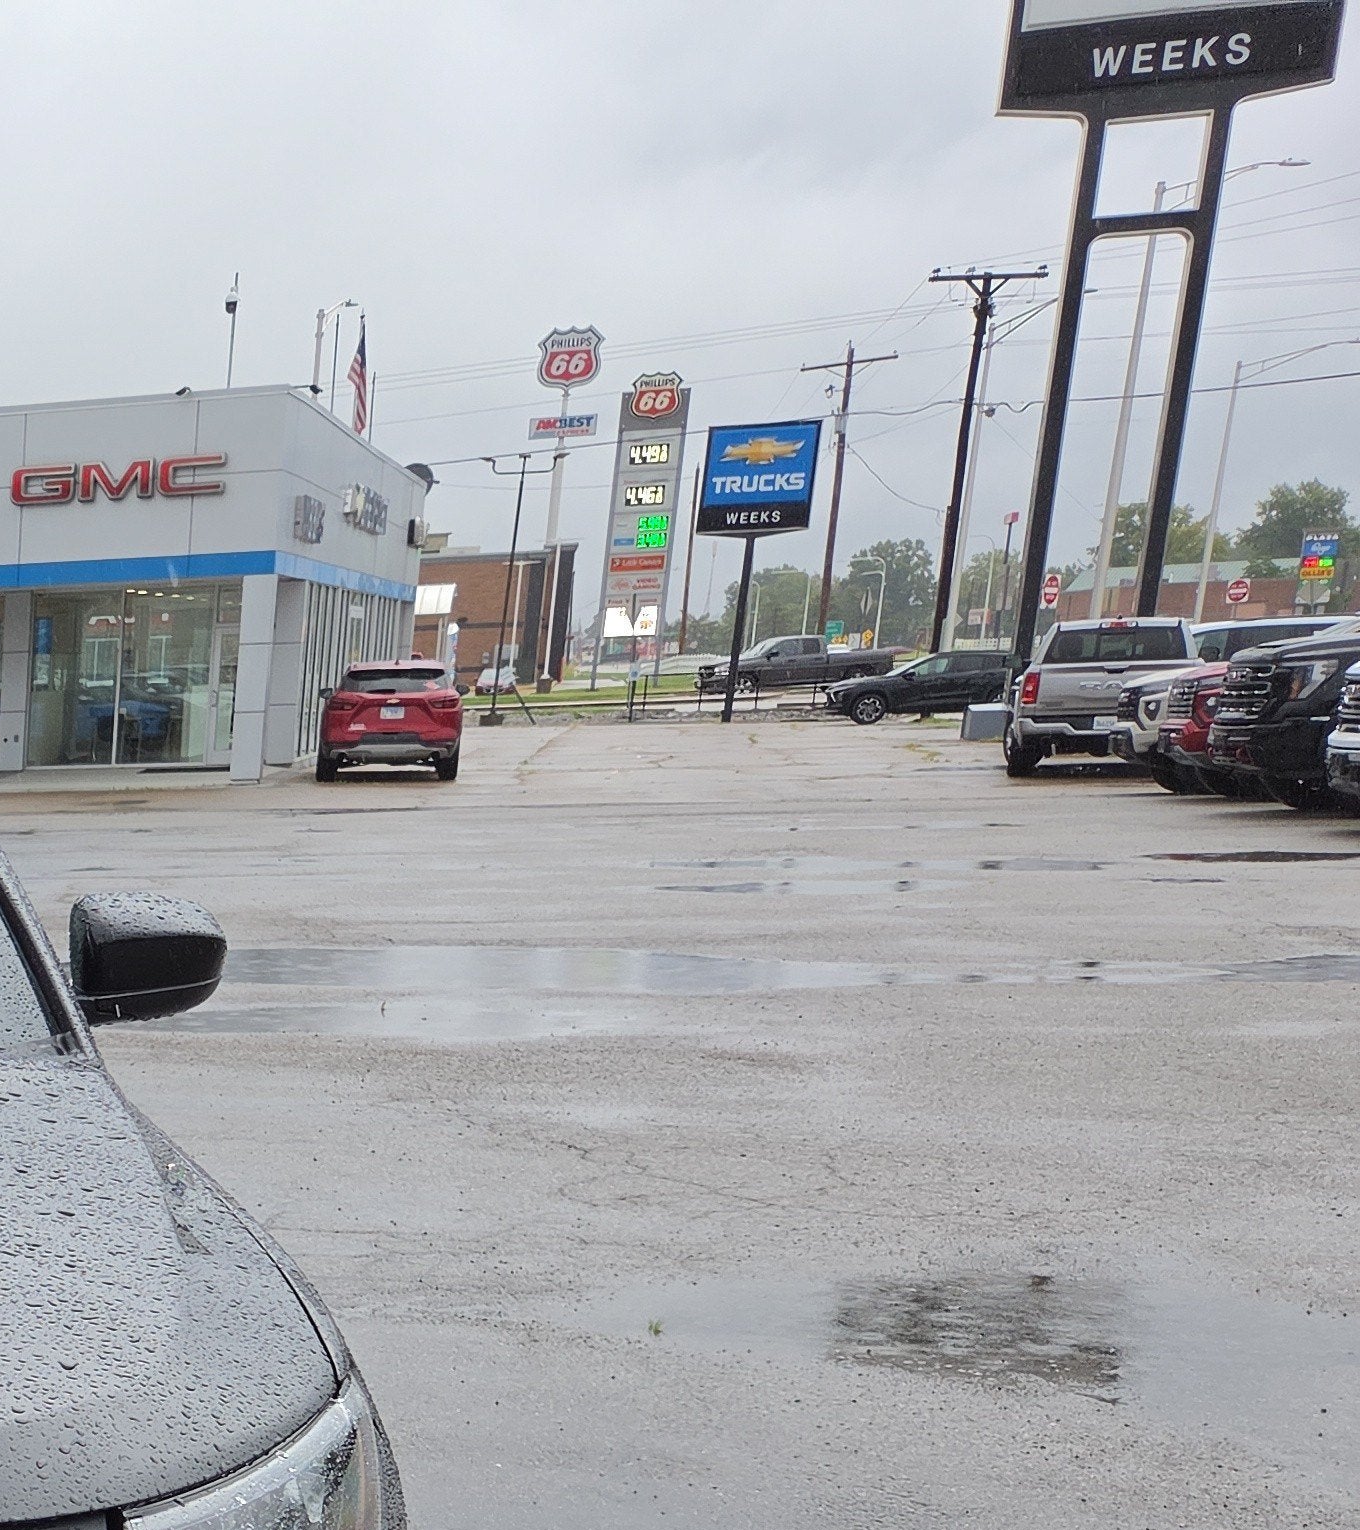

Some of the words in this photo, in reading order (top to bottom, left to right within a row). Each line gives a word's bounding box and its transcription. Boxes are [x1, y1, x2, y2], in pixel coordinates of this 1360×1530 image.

[1092, 32, 1252, 78] WEEKS
[550, 336, 593, 349] PHILLIPS
[550, 352, 589, 376] 66
[639, 377, 676, 388] PHILLIPS
[638, 391, 672, 411] 66
[10, 451, 228, 506] GMC
[712, 472, 805, 494] TRUCKS
[726, 510, 781, 525] WEEKS
